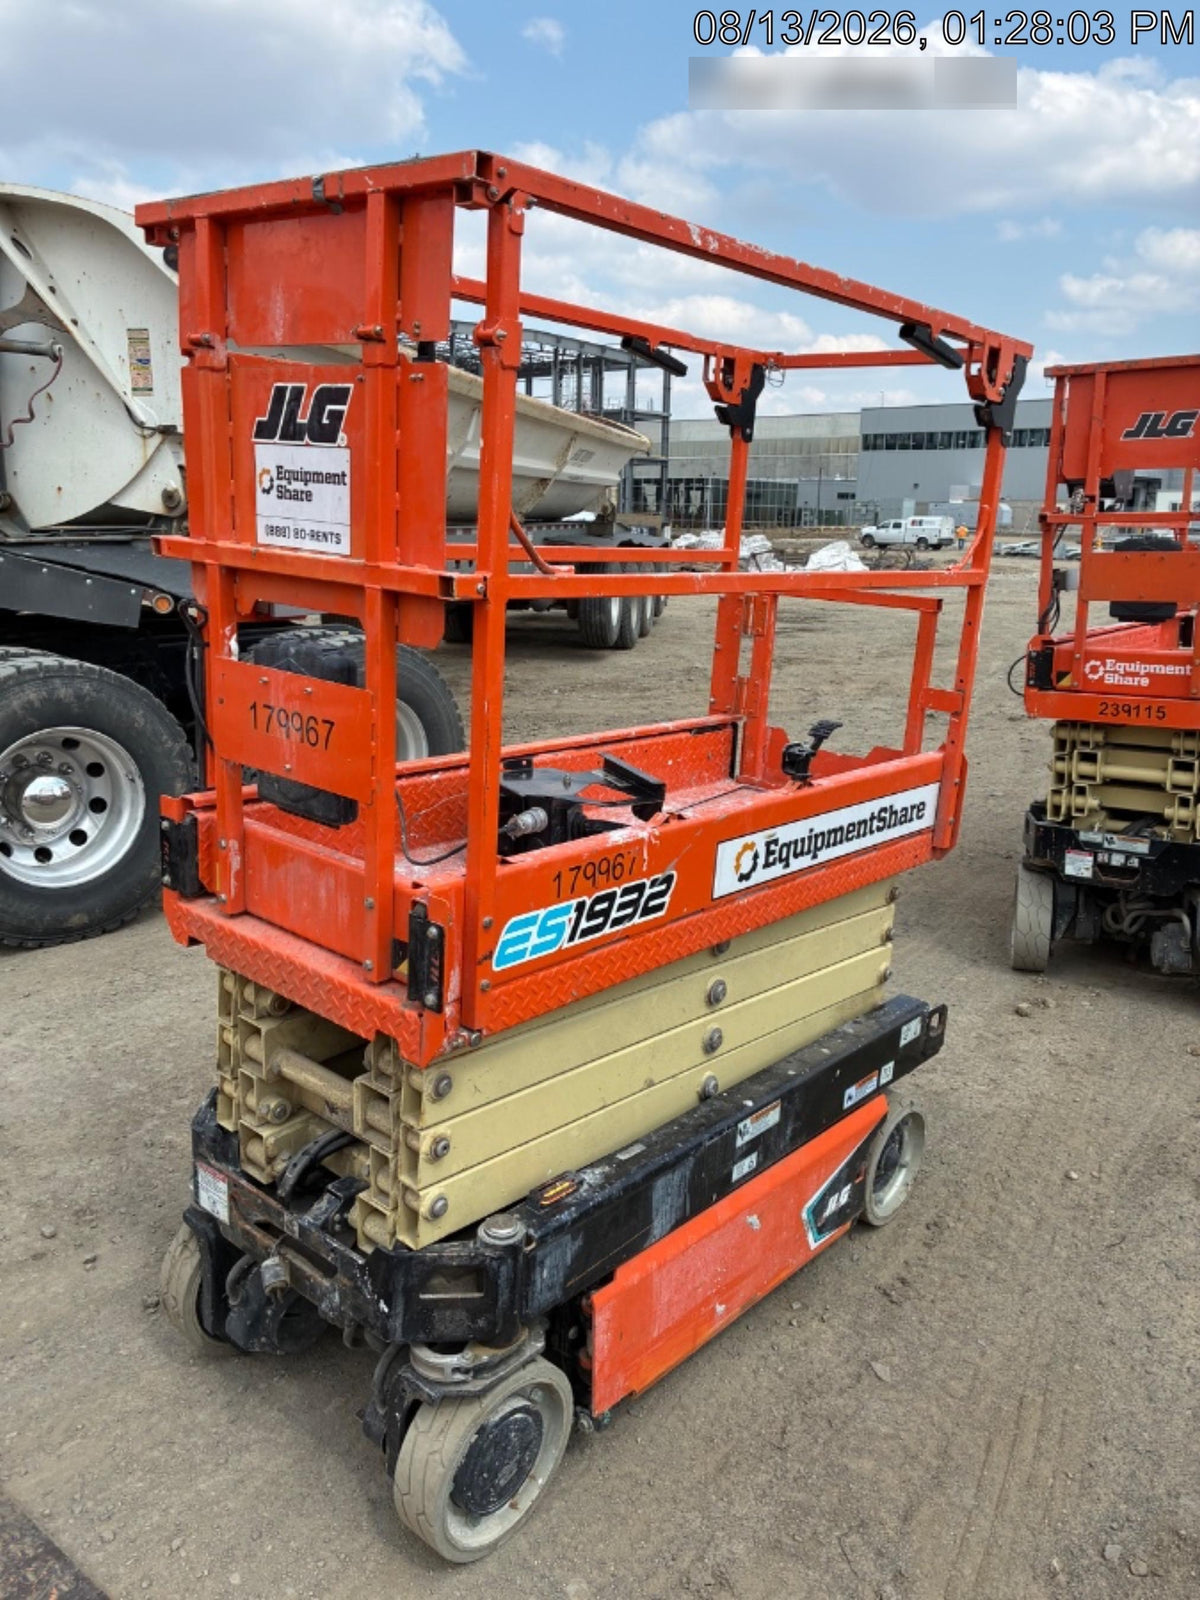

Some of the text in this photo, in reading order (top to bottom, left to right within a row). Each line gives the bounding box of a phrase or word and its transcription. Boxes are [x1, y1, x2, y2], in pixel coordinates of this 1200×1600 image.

[252, 383, 354, 446] JLG
[1120, 409, 1200, 441] JLG
[275, 465, 347, 486] Equipment
[276, 484, 313, 502] Share
[1104, 673, 1150, 687] Share
[1105, 659, 1192, 676] Equipment
[1098, 701, 1166, 721] 239115
[249, 701, 335, 751] 179967
[762, 801, 926, 869] EquipmentShare
[492, 870, 677, 972] ES1932
